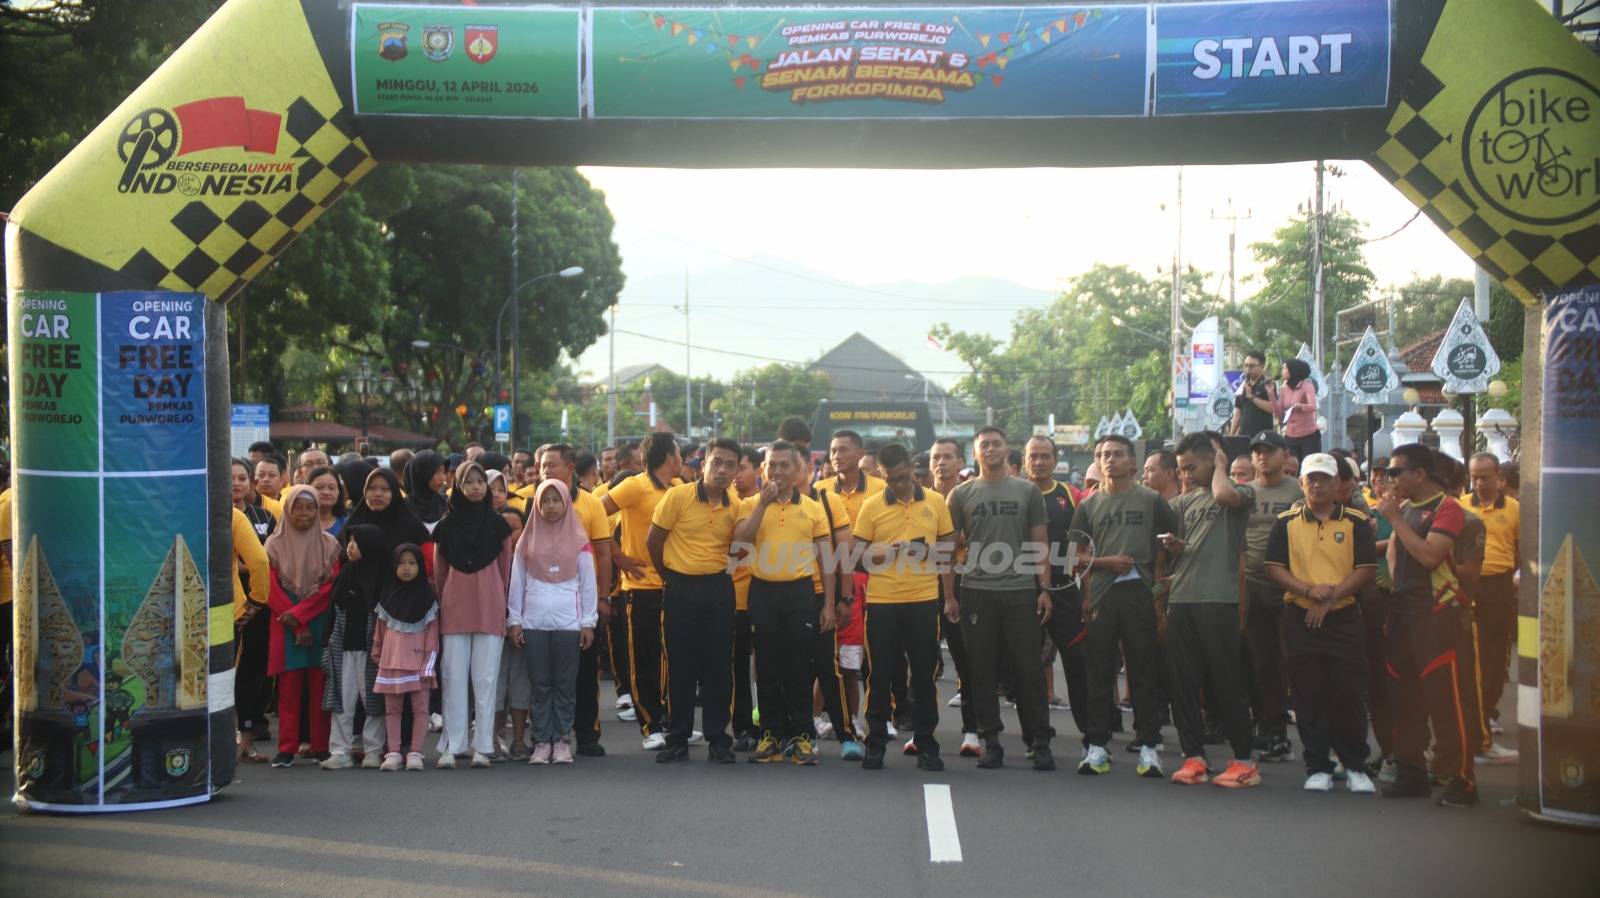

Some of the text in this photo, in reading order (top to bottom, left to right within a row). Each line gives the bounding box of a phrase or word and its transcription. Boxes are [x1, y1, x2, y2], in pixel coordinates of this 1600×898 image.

[782, 20, 954, 36] OPENING CAR FREE DAY
[789, 31, 947, 46] PEMKAB PURWOREJO
[769, 46, 968, 69] JALAN SEHAT &
[1192, 33, 1352, 80] START
[376, 79, 539, 93] MINGGU, 12 APRIL 2026
[762, 64, 975, 87] SENAM BERSAMA
[791, 82, 945, 101] FORKOPIMDA
[1500, 87, 1591, 127] bike
[20, 298, 67, 311] OPENING
[132, 300, 193, 312] OPENING
[20, 313, 70, 339] CAR
[128, 314, 192, 340] CAR
[21, 343, 82, 369] FREE
[119, 344, 194, 369] FREE
[22, 373, 68, 398] DAY
[133, 373, 192, 399] DAY
[148, 401, 194, 411] PEMKAB
[119, 413, 194, 425] PURWOREJO
[497, 408, 508, 430] P
[971, 501, 1019, 517] 412
[1100, 510, 1143, 527] 412
